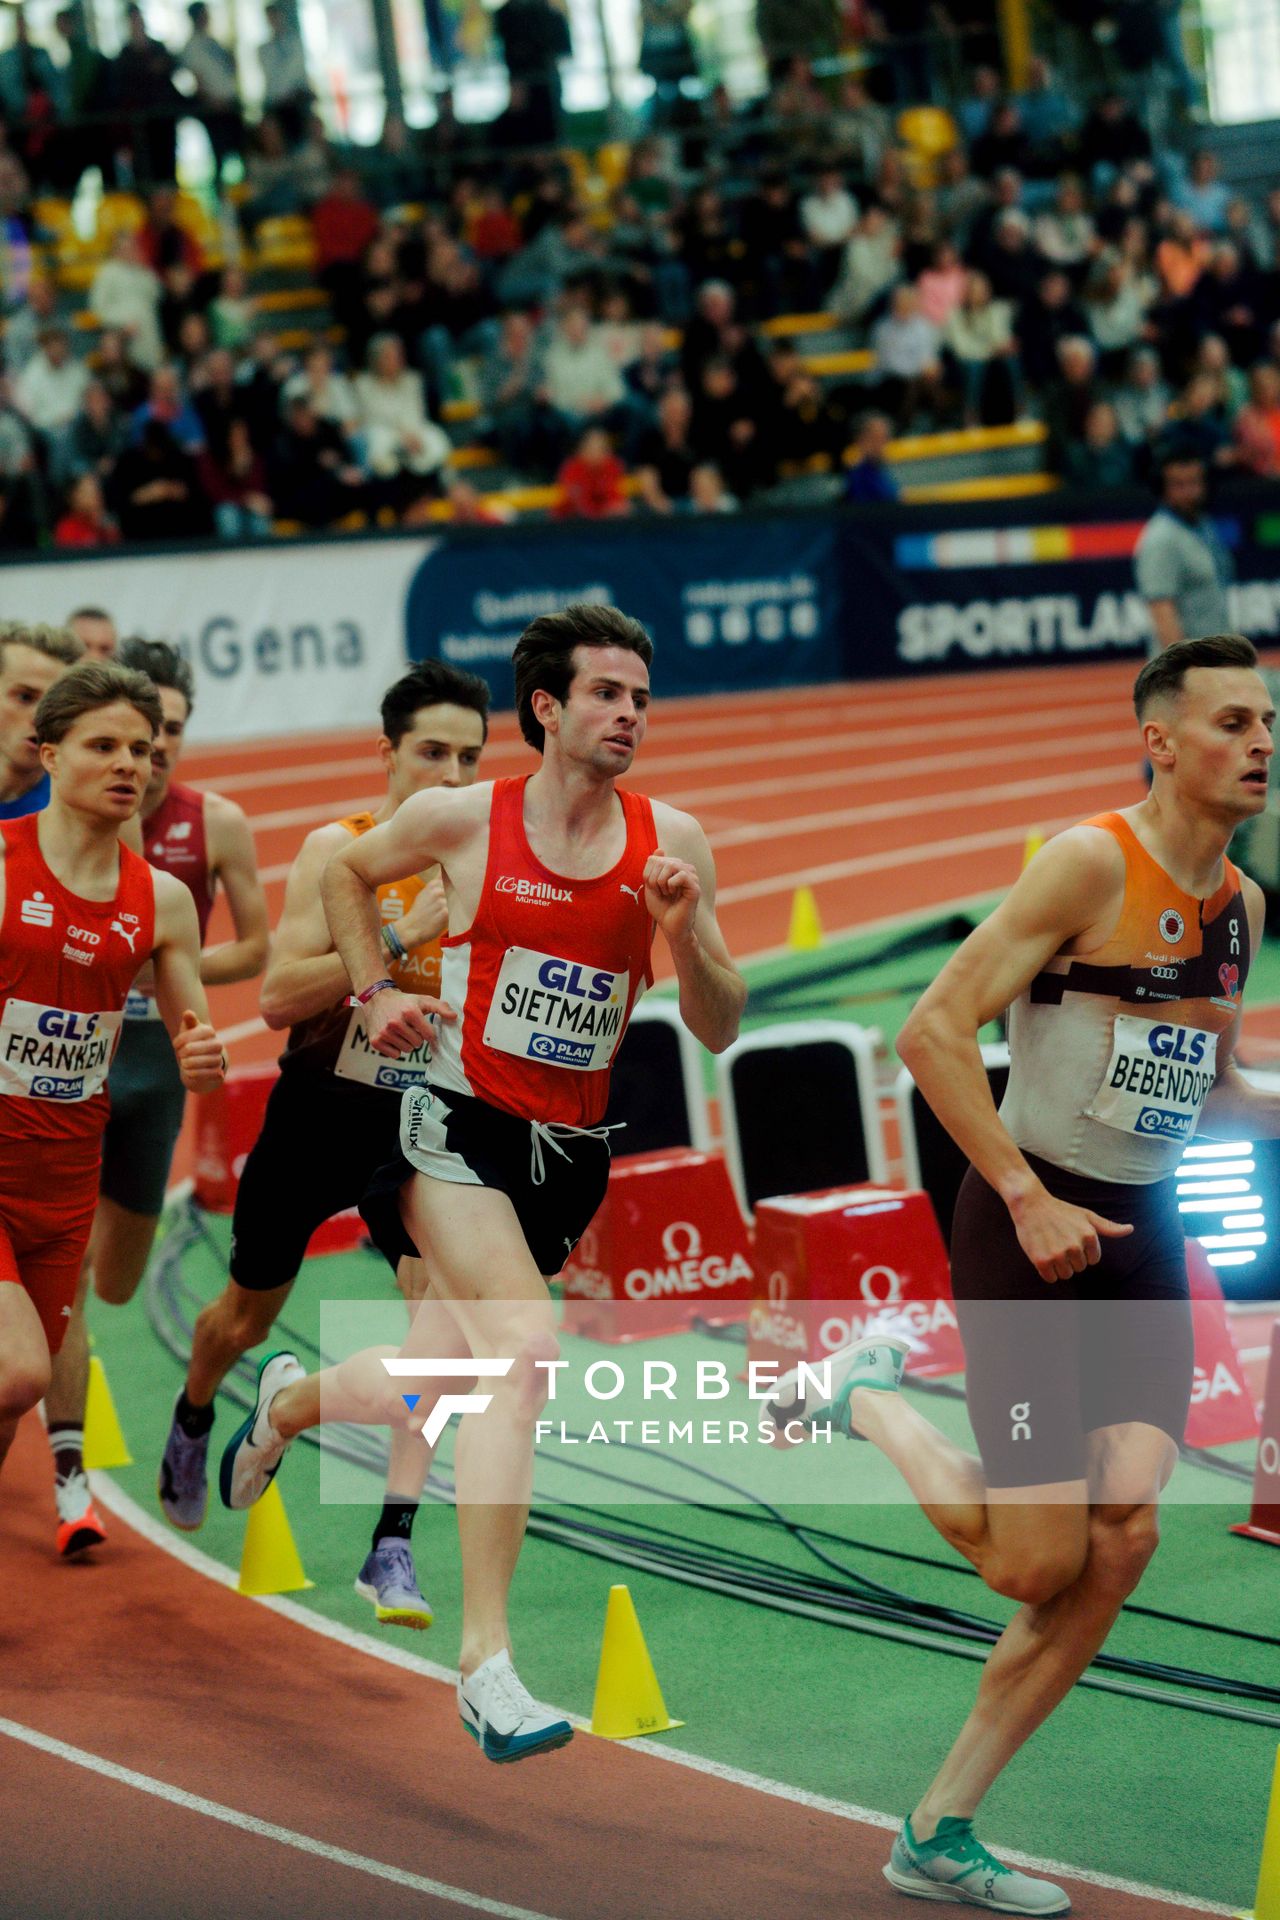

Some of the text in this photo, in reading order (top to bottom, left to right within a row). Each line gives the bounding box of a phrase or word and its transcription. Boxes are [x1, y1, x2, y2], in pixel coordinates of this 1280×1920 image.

[898, 591, 1150, 661] SPORTLAN
[515, 895, 551, 907] Münster
[517, 879, 573, 902] Brillux
[501, 983, 623, 1037] SIETMANN
[5, 1033, 109, 1072] FRANKEN
[557, 1043, 592, 1059] PLAN
[1148, 1025, 1207, 1066] GLS
[56, 1080, 82, 1093] PLAN
[1161, 1115, 1191, 1132] PLAN
[624, 1252, 755, 1302] OMEGA
